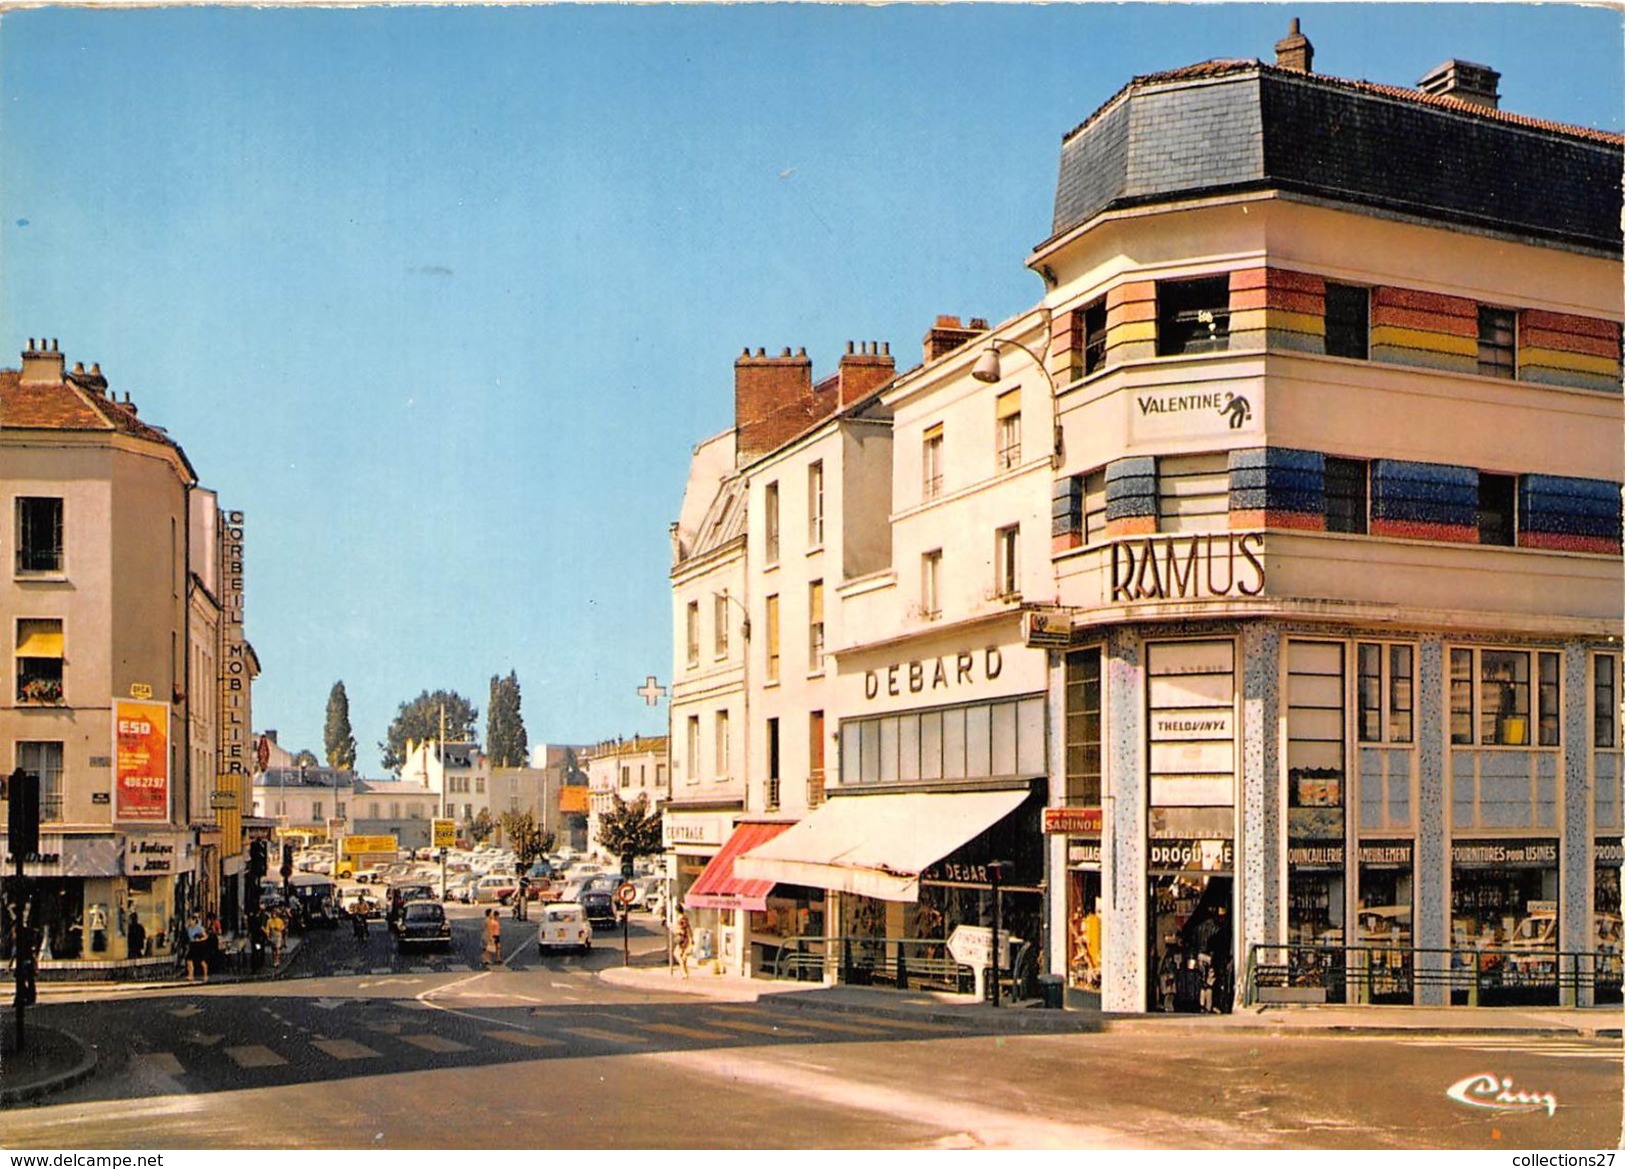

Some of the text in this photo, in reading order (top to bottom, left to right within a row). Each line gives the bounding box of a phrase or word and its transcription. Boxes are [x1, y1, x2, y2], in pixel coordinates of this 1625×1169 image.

[1137, 392, 1222, 415] VALENTINE
[229, 510, 245, 625] CORBEIL
[1111, 532, 1265, 601] RAMUS
[865, 643, 1003, 700] DEBARD
[229, 644, 244, 774] MOBILIER
[1157, 720, 1226, 732] THELOVINYL
[666, 826, 704, 840] CENTRALE
[1068, 846, 1101, 861] OUTILLAG
[1151, 846, 1233, 863] DROGUIE
[1287, 847, 1343, 863] QUINCAILLERIE
[1359, 846, 1412, 862] AMEUBLEMENT
[1450, 846, 1505, 862] FOURNITURES
[1525, 846, 1557, 861] USINES
[944, 863, 1002, 882] DEBAR
